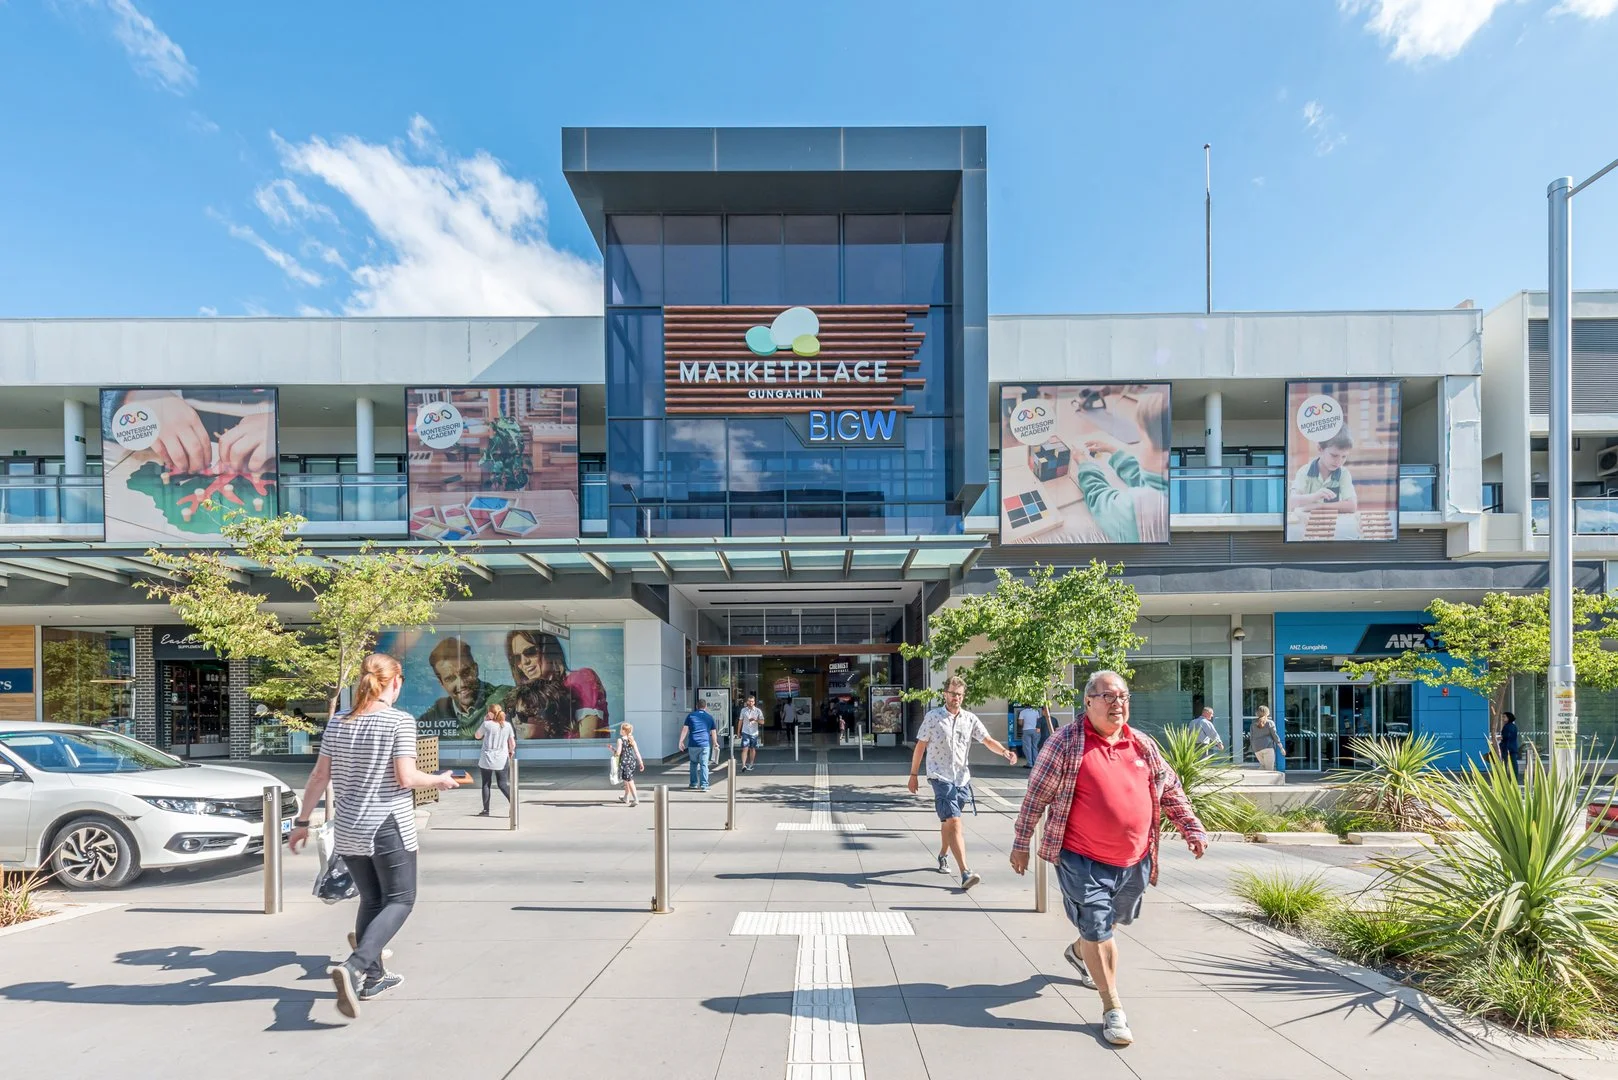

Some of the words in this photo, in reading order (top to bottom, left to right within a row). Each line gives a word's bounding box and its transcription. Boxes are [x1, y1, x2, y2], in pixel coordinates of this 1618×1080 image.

[679, 361, 888, 383] MARKETPLACE
[748, 389, 823, 399] GUNGAHLIN
[1014, 419, 1054, 433] MONTESSORI
[1300, 415, 1341, 429] MONTESSORI
[1307, 422, 1337, 434] ACADEMY
[116, 424, 157, 438] MONTESSORI
[420, 422, 460, 436] MONTESSORI
[427, 430, 457, 440] ACADEMY
[1020, 426, 1050, 438] ACADEMY
[123, 431, 153, 442] ACADEMY
[160, 634, 188, 645] East
[1385, 634, 1425, 648] ANZ
[434, 720, 460, 729] LOVE,
